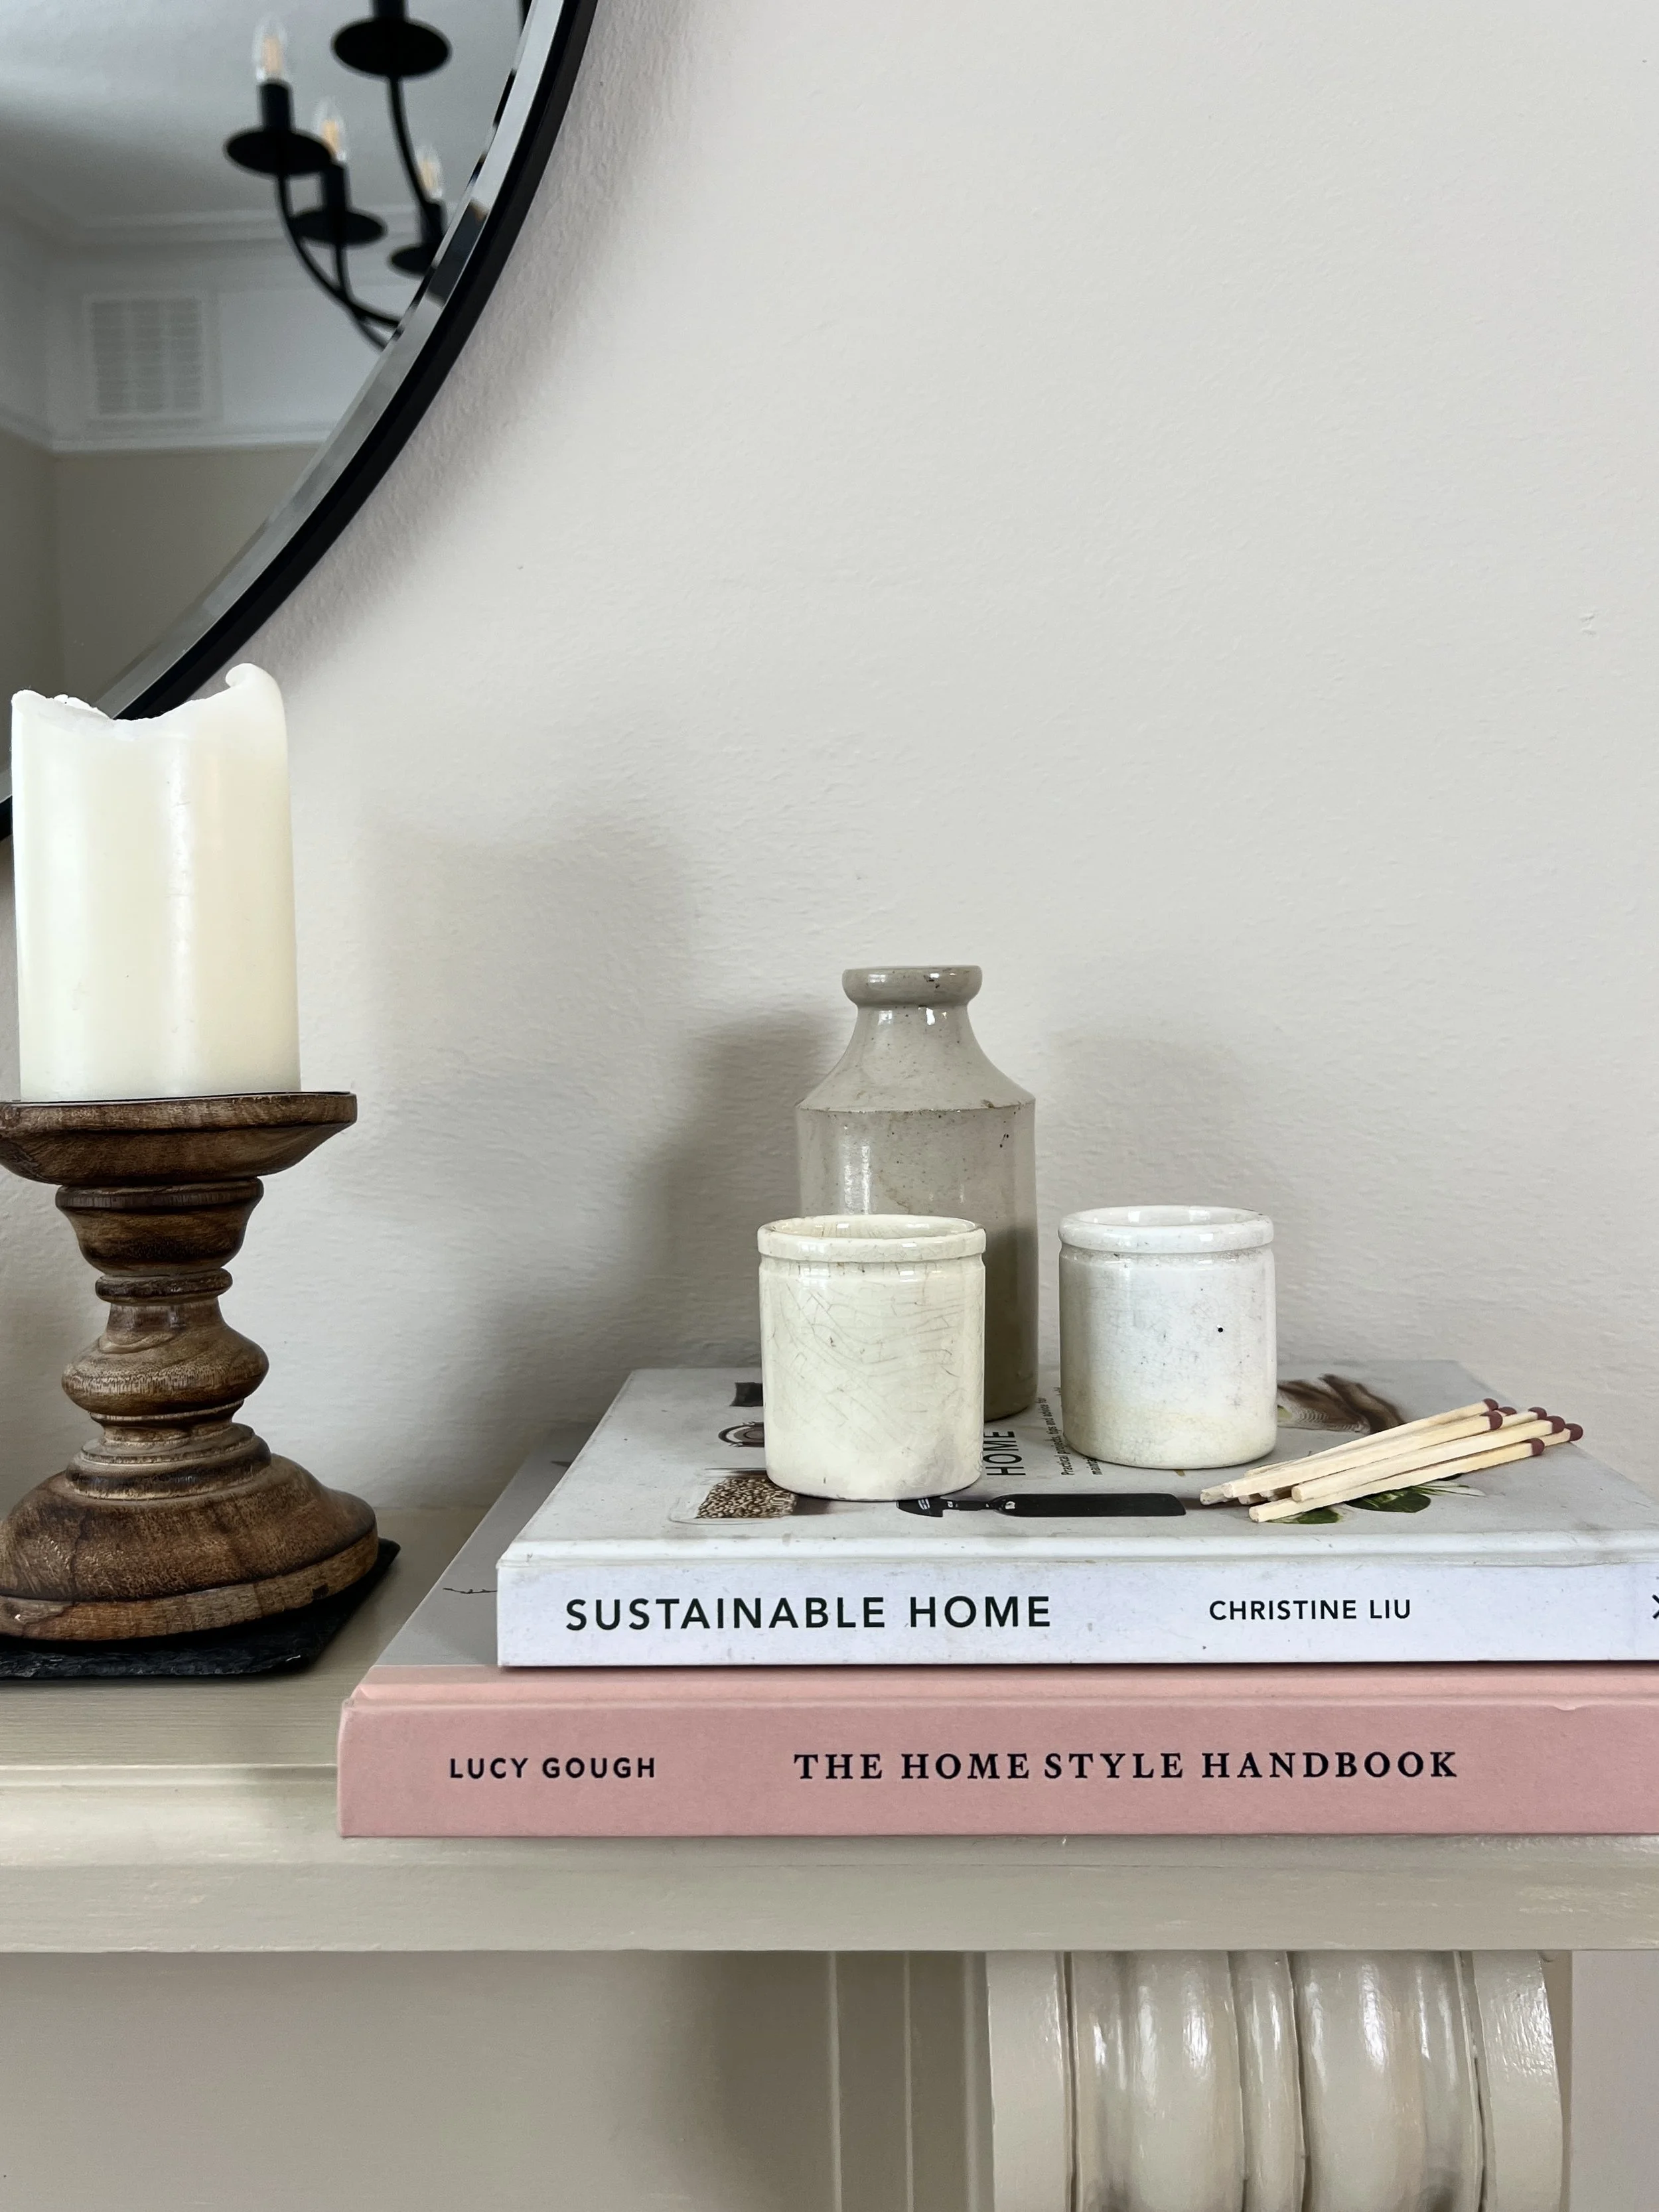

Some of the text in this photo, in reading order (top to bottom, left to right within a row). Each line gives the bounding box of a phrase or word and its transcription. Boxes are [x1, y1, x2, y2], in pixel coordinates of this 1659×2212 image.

[1038, 1404, 1052, 1417] advice
[1041, 1417, 1056, 1426] and
[983, 1431, 1026, 1475] HOME
[1054, 1455, 1074, 1475] Practical
[566, 1596, 1050, 1631] SUSTAINABLE HOME
[1209, 1599, 1411, 1621] CHRISTINE LIU
[450, 1757, 656, 1779] LUCY GOUGH
[794, 1751, 1458, 1779] THE HOME STYLE HANDBOOK
